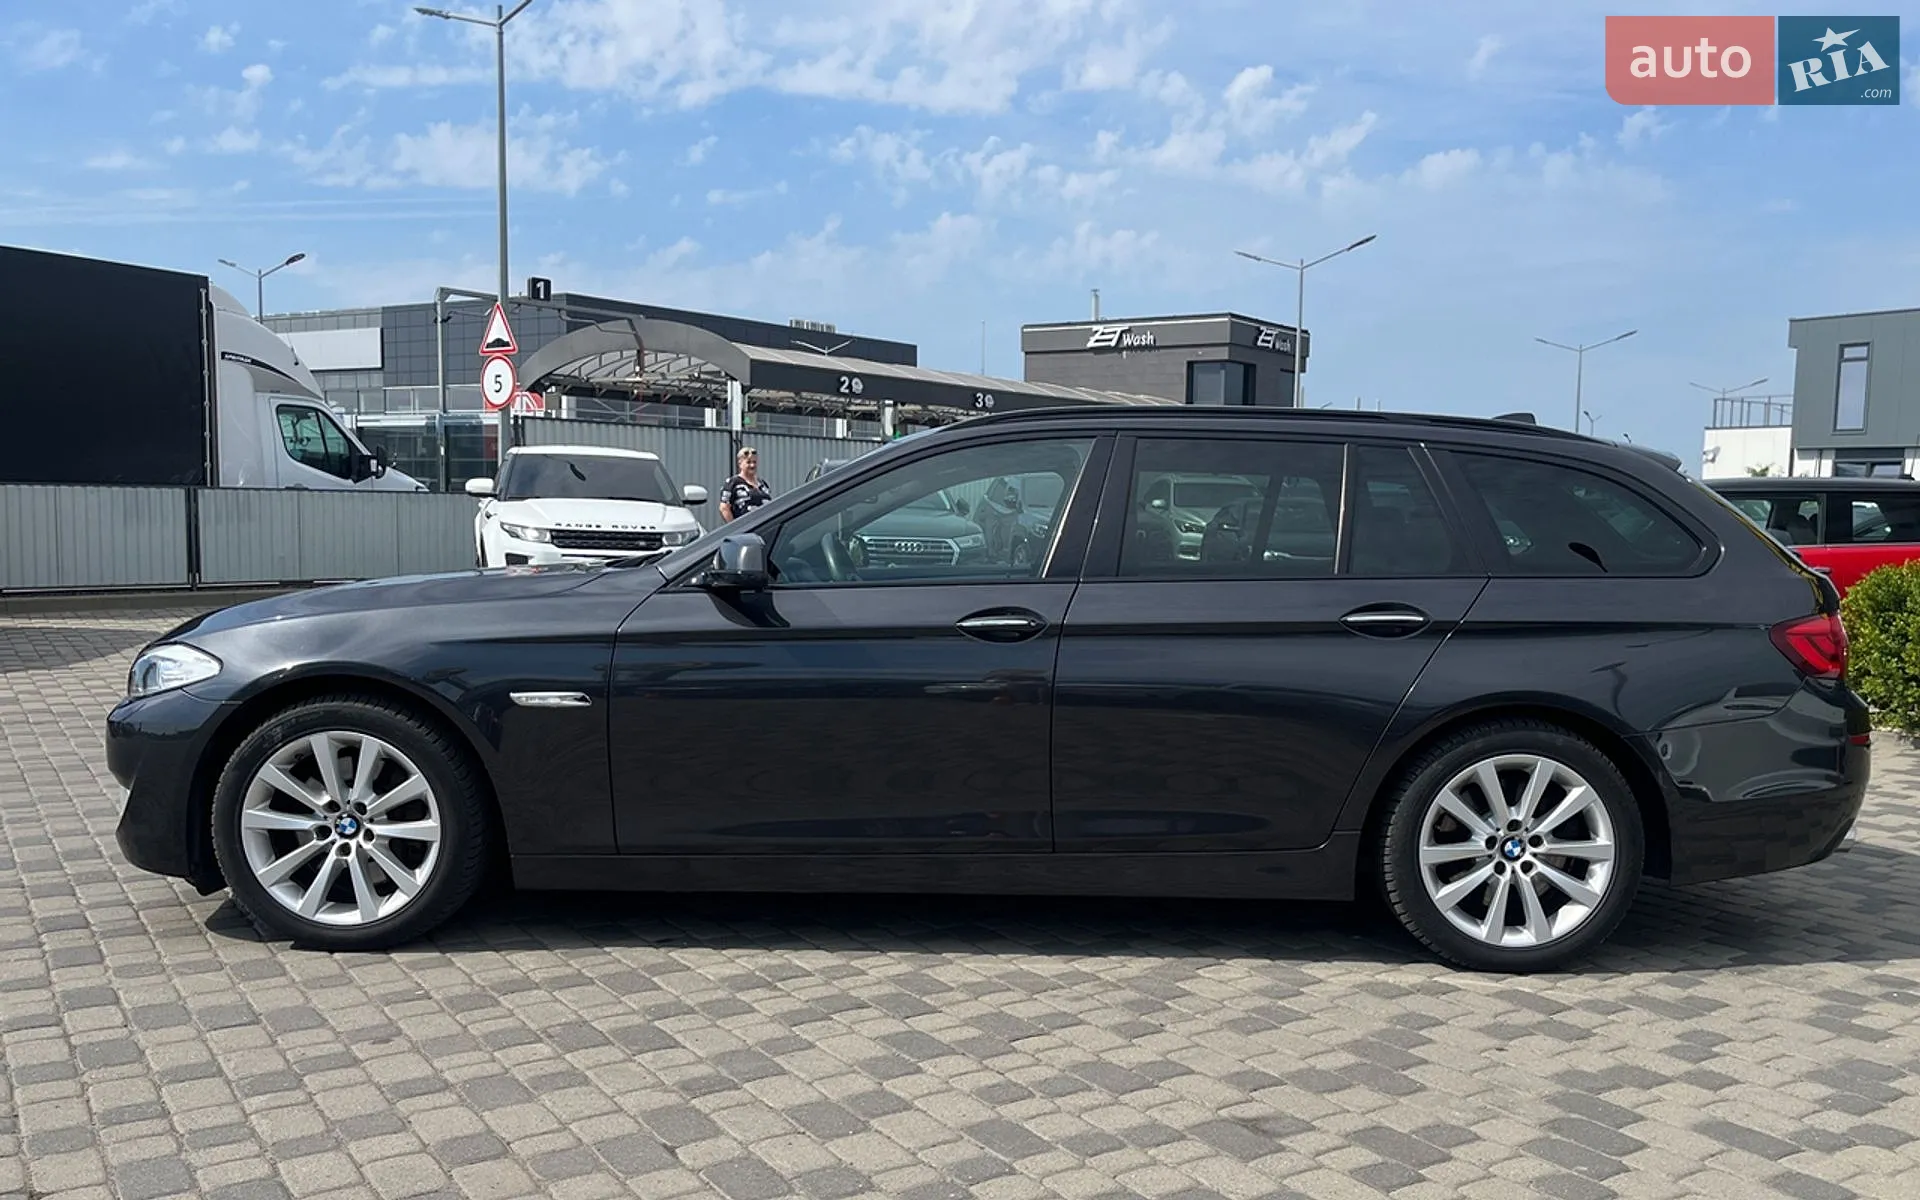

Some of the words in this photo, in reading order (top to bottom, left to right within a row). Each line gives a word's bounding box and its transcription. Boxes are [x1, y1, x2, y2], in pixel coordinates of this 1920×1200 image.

[535, 281, 545, 300] 1
[1122, 333, 1154, 347] Wash
[493, 374, 503, 393] 5
